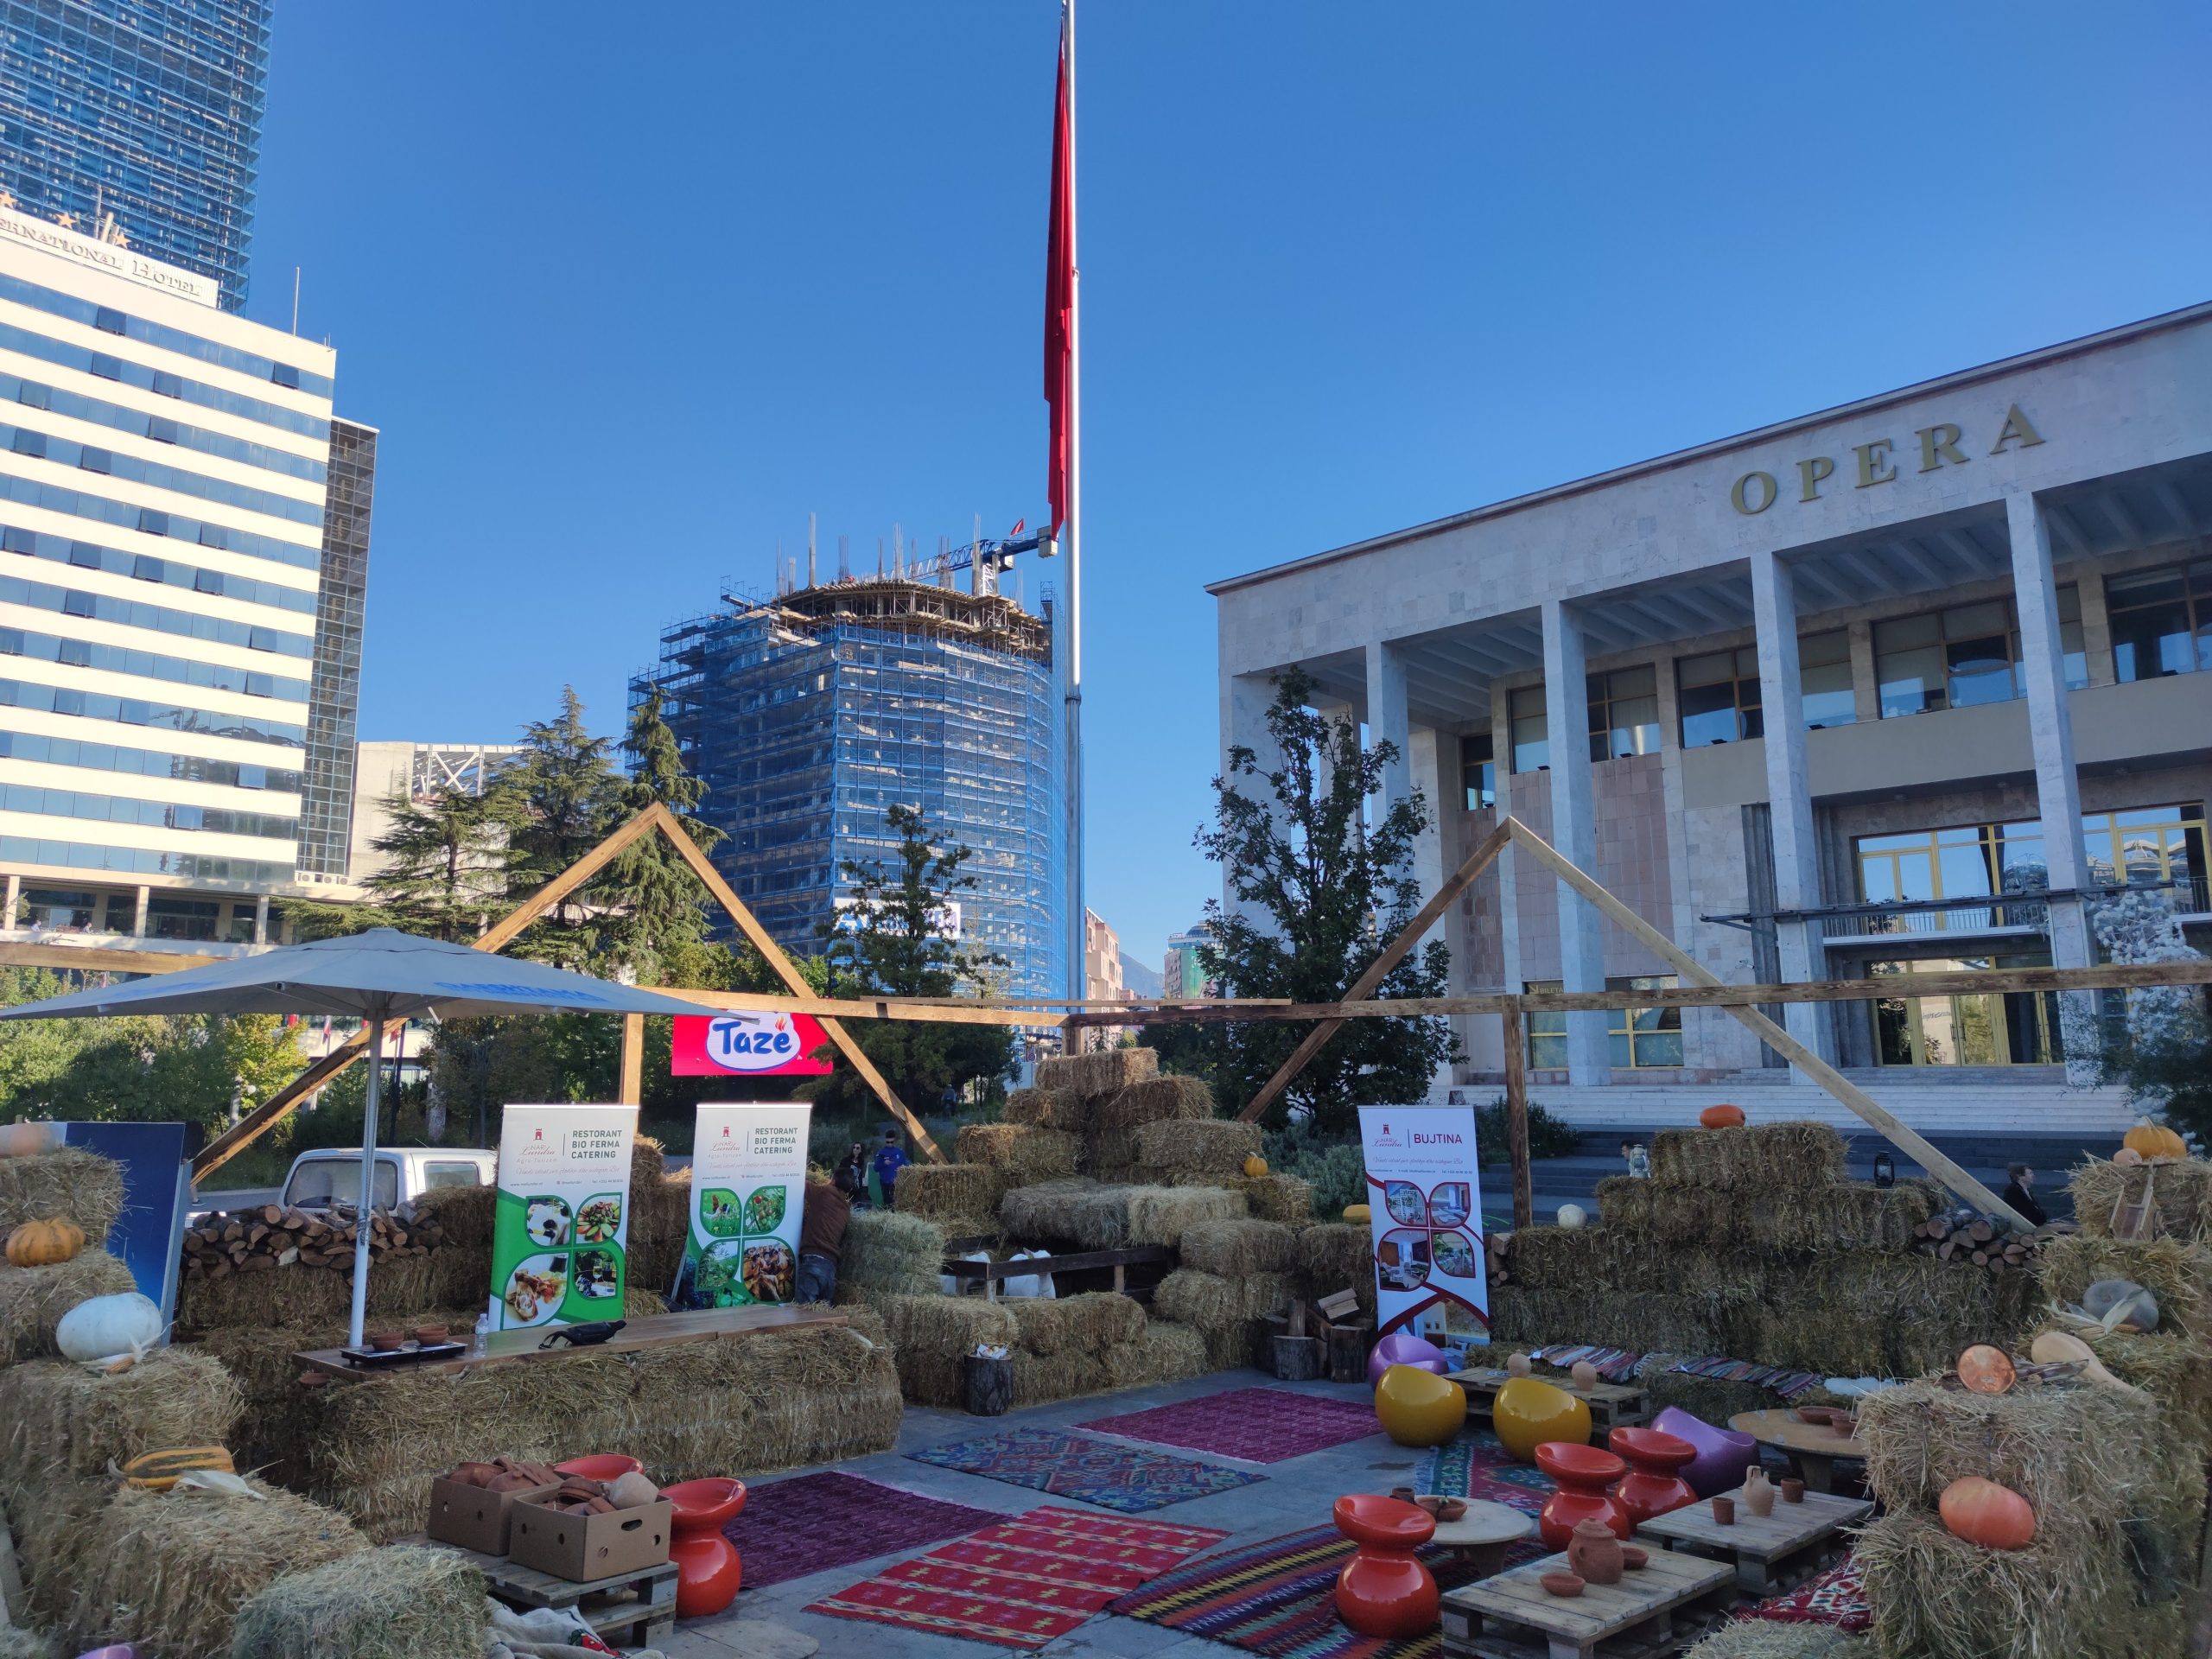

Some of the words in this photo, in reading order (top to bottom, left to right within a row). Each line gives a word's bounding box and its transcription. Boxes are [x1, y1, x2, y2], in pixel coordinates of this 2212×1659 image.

[1731, 403, 2046, 515] OPERA
[572, 1129, 622, 1138] RESTORANT
[755, 1127, 798, 1135] RESTORANT
[770, 1136, 797, 1145] FERMA
[1414, 1133, 1463, 1144] BUJTINA
[590, 1140, 620, 1148] FERMA
[571, 1150, 616, 1159] CATERING
